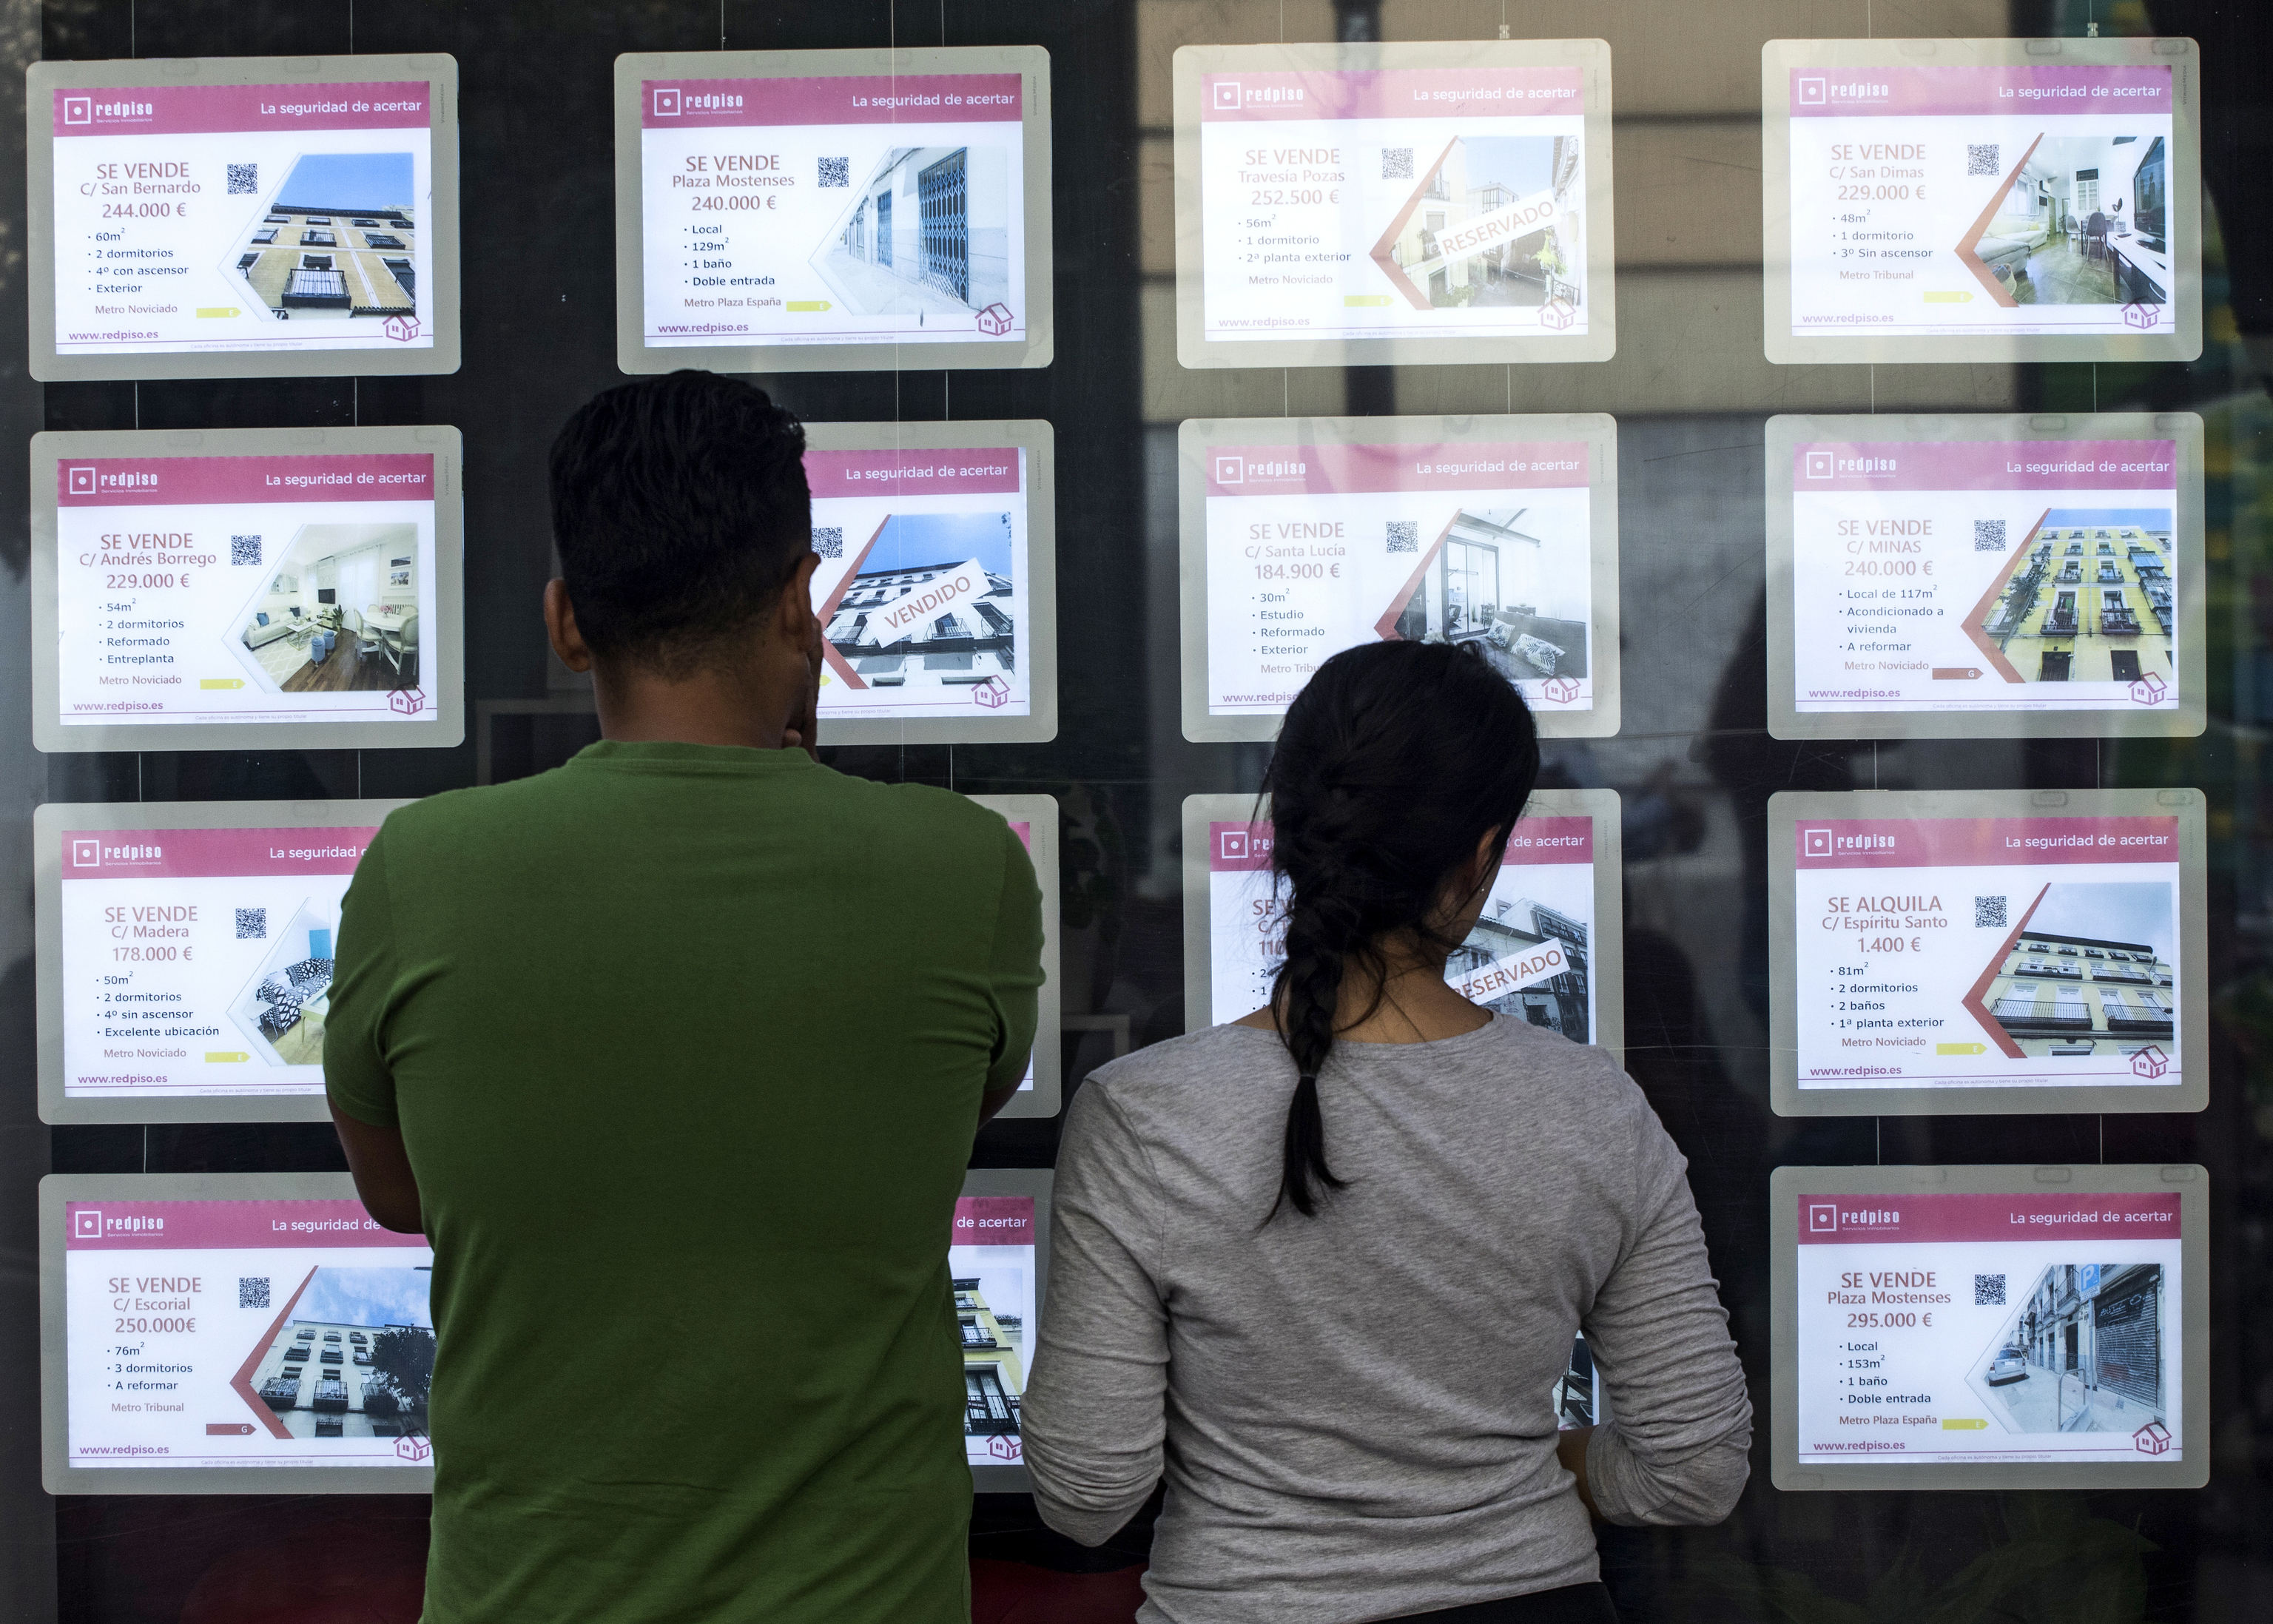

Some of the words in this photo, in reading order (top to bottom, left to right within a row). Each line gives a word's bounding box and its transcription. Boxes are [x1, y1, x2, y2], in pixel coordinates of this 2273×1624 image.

[686, 94, 743, 109] redpiso
[1247, 87, 1304, 103] redpiso
[96, 102, 152, 118] redpiso
[261, 103, 276, 114] La
[280, 101, 347, 116] seguridad
[352, 101, 369, 112] de
[374, 101, 421, 112] acertar
[1246, 150, 1267, 166] SE
[1273, 148, 1340, 164] VENDE
[1832, 145, 1853, 161] SE
[1859, 144, 1926, 160] VENDE
[97, 164, 118, 179] SE
[124, 162, 189, 178] VENDE
[686, 156, 707, 172] SE
[714, 155, 780, 171] VENDE
[673, 175, 710, 187] Plaza
[716, 174, 795, 186] Mostenses
[1238, 169, 1298, 183] Travesía
[1303, 169, 1345, 182] Pozas
[1829, 166, 1845, 180] C/
[1850, 166, 1876, 178] San
[1881, 166, 1924, 178] Dimas
[81, 183, 98, 197] C/
[102, 182, 128, 195] San
[133, 181, 201, 195] Bernardo
[1838, 186, 1908, 201] 229.000
[1916, 185, 1926, 200] €
[692, 196, 761, 211] 240.000
[767, 195, 776, 209] €
[1251, 190, 1322, 205] 252.500
[1329, 189, 1339, 204] €
[103, 203, 170, 218] 244.000
[176, 203, 186, 216] €
[693, 225, 722, 234] Local
[1441, 201, 1555, 256] RESERVADO
[1264, 252, 1300, 265] planta
[1305, 254, 1351, 262] exterior
[1859, 249, 1876, 257] Sin
[693, 260, 698, 269] 1
[703, 260, 732, 269] baño
[693, 276, 725, 286] Doble
[730, 276, 775, 285] entrada
[1839, 271, 1870, 280] Metro
[1873, 270, 1913, 280] Tribunal
[96, 285, 143, 293] Exterior
[69, 331, 158, 340] www.redpiso.es
[846, 468, 861, 479] La
[865, 466, 933, 481] seguridad
[938, 466, 955, 477] de
[960, 465, 1008, 476] acertar
[1839, 457, 1895, 474] redpiso
[101, 472, 158, 488] redpiso
[1250, 524, 1271, 539] SE
[1278, 522, 1344, 539] VENDE
[1838, 520, 1859, 536] SE
[1866, 520, 1932, 536] VENDE
[101, 534, 122, 550] SE
[127, 533, 192, 549] VENDE
[1847, 541, 1864, 555] C/
[1869, 541, 1922, 553] MINAS
[1245, 546, 1261, 559] C/
[1265, 546, 1305, 558] Santa
[1310, 543, 1346, 556] Lucía
[80, 553, 96, 567] C/
[101, 552, 152, 566] Andrés
[158, 552, 216, 567] Borrego
[1254, 564, 1323, 579] 184.900
[1330, 563, 1340, 578] €
[1845, 561, 1916, 576] 240.000
[1922, 561, 1933, 576] €
[107, 574, 174, 589] 229.000
[180, 573, 189, 588] €
[1848, 590, 1877, 599] Local
[1882, 590, 1896, 598] de
[884, 576, 971, 629] VENDIDO
[1261, 610, 1304, 620] Estudio
[1847, 606, 1933, 616] Acondicionado
[1937, 608, 1944, 616] a
[1261, 627, 1325, 637] Reformado
[1847, 624, 1896, 634] vivienda
[107, 636, 169, 647] Reformado
[1261, 645, 1308, 654] Exterior
[107, 654, 174, 664] Entreplanta
[1514, 835, 1531, 846] de
[1536, 836, 1584, 847] acertar
[1828, 897, 1850, 913] SE
[1856, 896, 1942, 913] ALQUILA
[105, 907, 125, 923] SE
[132, 906, 198, 922] VENDE
[1822, 917, 1839, 931] C/
[1844, 915, 1899, 932] Espíritu
[1905, 915, 1948, 929] Santo
[111, 926, 128, 940] C/
[134, 925, 189, 938] Madera
[1859, 937, 1904, 952] 1.400
[1910, 937, 1921, 951] €
[113, 947, 176, 962] 178.000
[183, 946, 192, 960] €
[105, 1027, 160, 1037] Excelente
[165, 1026, 219, 1036] ubicación
[1857, 1018, 1893, 1030] planta
[1898, 1018, 1944, 1028] exterior
[957, 1216, 974, 1228] de
[978, 1217, 1027, 1228] acertar
[1842, 1209, 1899, 1225] redpiso
[109, 1278, 130, 1293] SE
[136, 1277, 202, 1293] VENDE
[1842, 1273, 1863, 1289] SE
[1869, 1272, 1935, 1288] VENDE
[113, 1298, 130, 1312] C/
[135, 1297, 190, 1310] Escorial
[1828, 1291, 1866, 1304] Plaza
[1871, 1291, 1950, 1304] Mostenses
[115, 1318, 196, 1333] 250.000€
[1847, 1313, 1916, 1328] 295.000
[1922, 1313, 1932, 1327] €
[115, 1381, 123, 1390] A
[127, 1381, 178, 1390] reformar
[1848, 1394, 1881, 1403] Doble
[1886, 1393, 1931, 1404] entrada
[112, 1403, 141, 1412] Metro
[144, 1402, 184, 1412] Tribunal
[1839, 1416, 1870, 1424] Metro
[1873, 1415, 1899, 1425] Plaza
[1902, 1415, 1937, 1427] España
[80, 1446, 169, 1455] www.redpiso.es
[1814, 1441, 1905, 1452] www.redpiso.es
